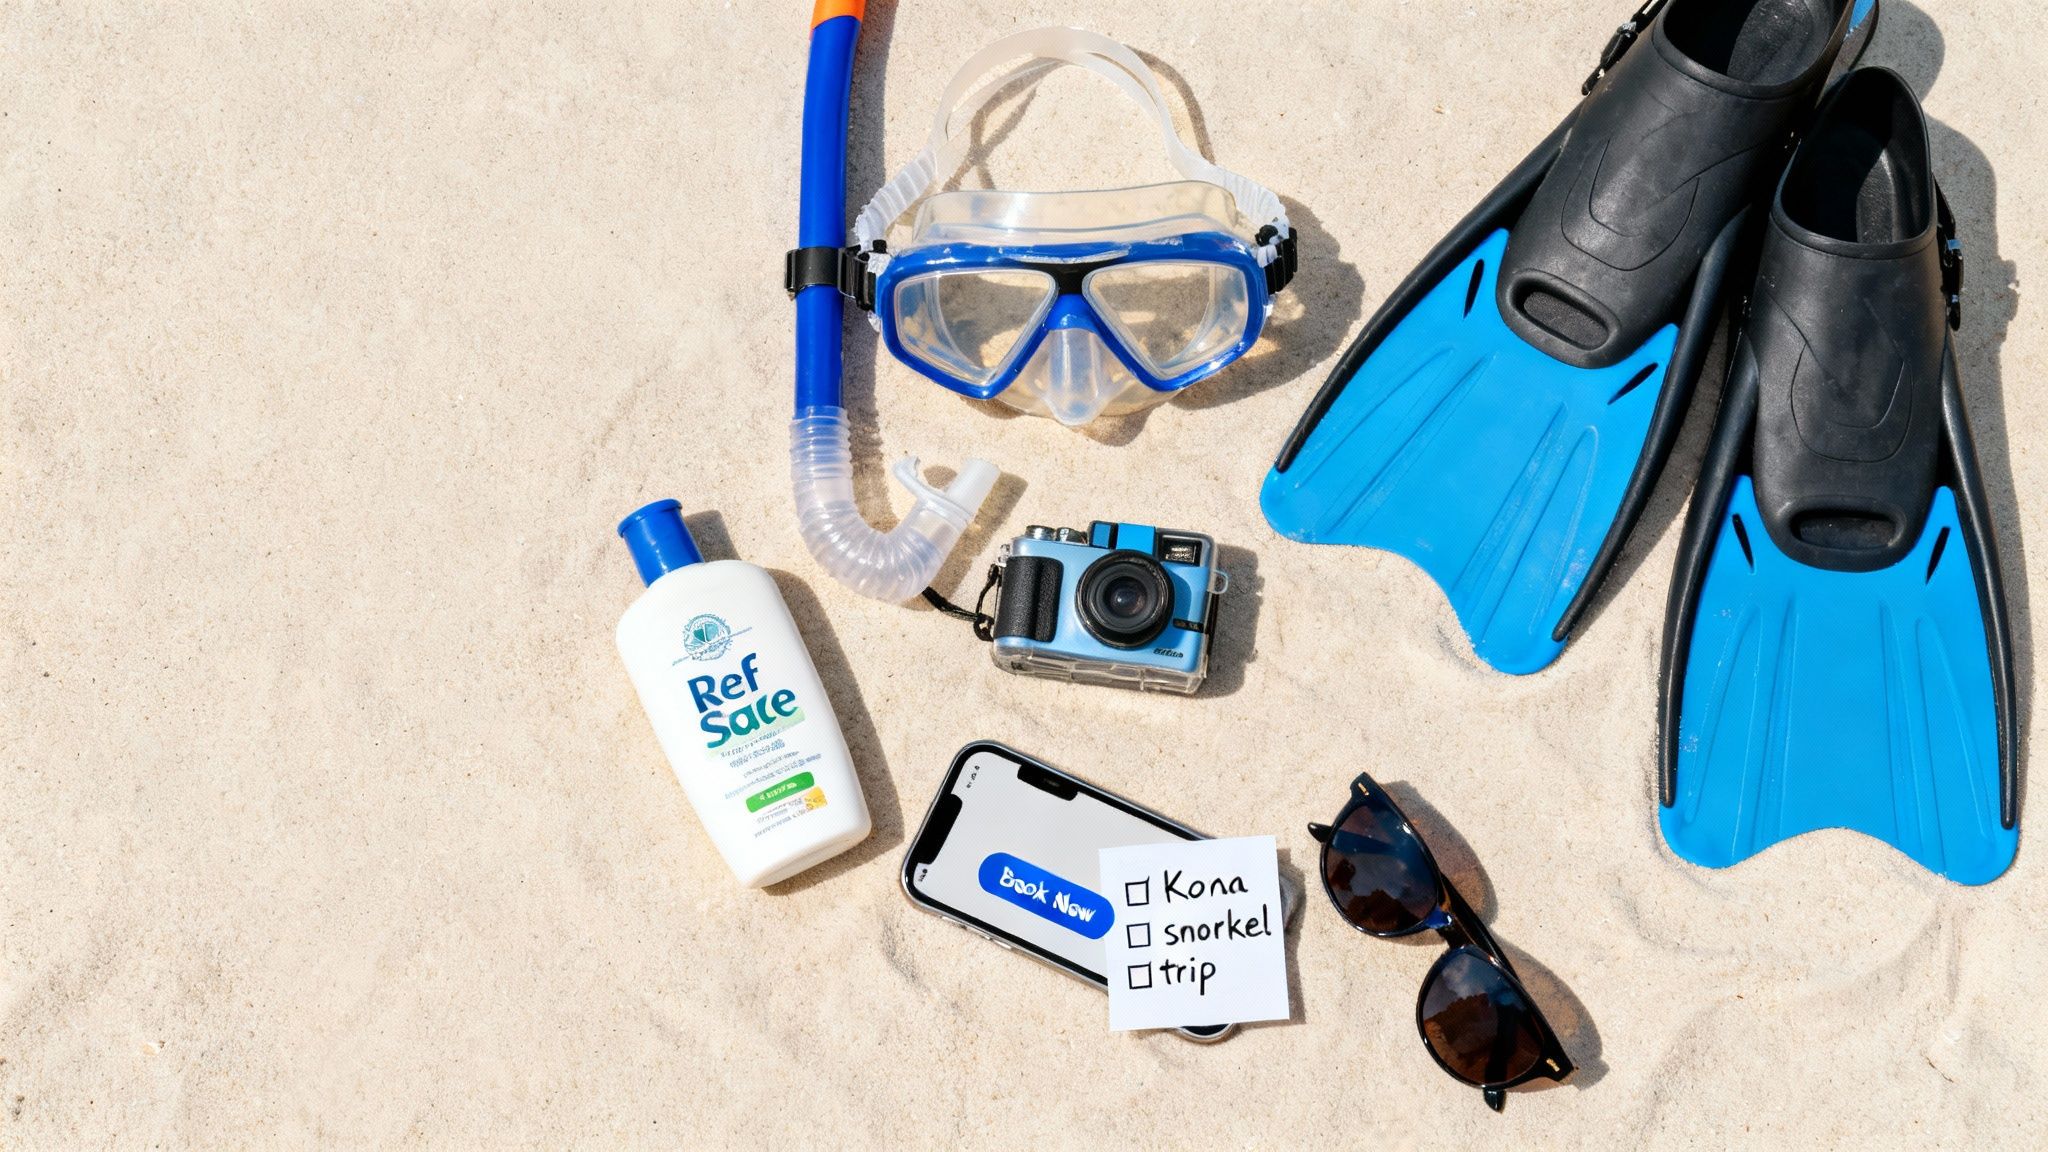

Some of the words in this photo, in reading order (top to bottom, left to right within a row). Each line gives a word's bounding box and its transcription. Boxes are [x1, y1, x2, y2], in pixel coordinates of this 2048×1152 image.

[687, 652, 758, 713] Ref
[999, 866, 1050, 904] Book
[1052, 891, 1097, 923] Now
[1163, 868, 1249, 903] Kona
[1164, 903, 1272, 946] snorkel
[1159, 957, 1216, 996] trip
